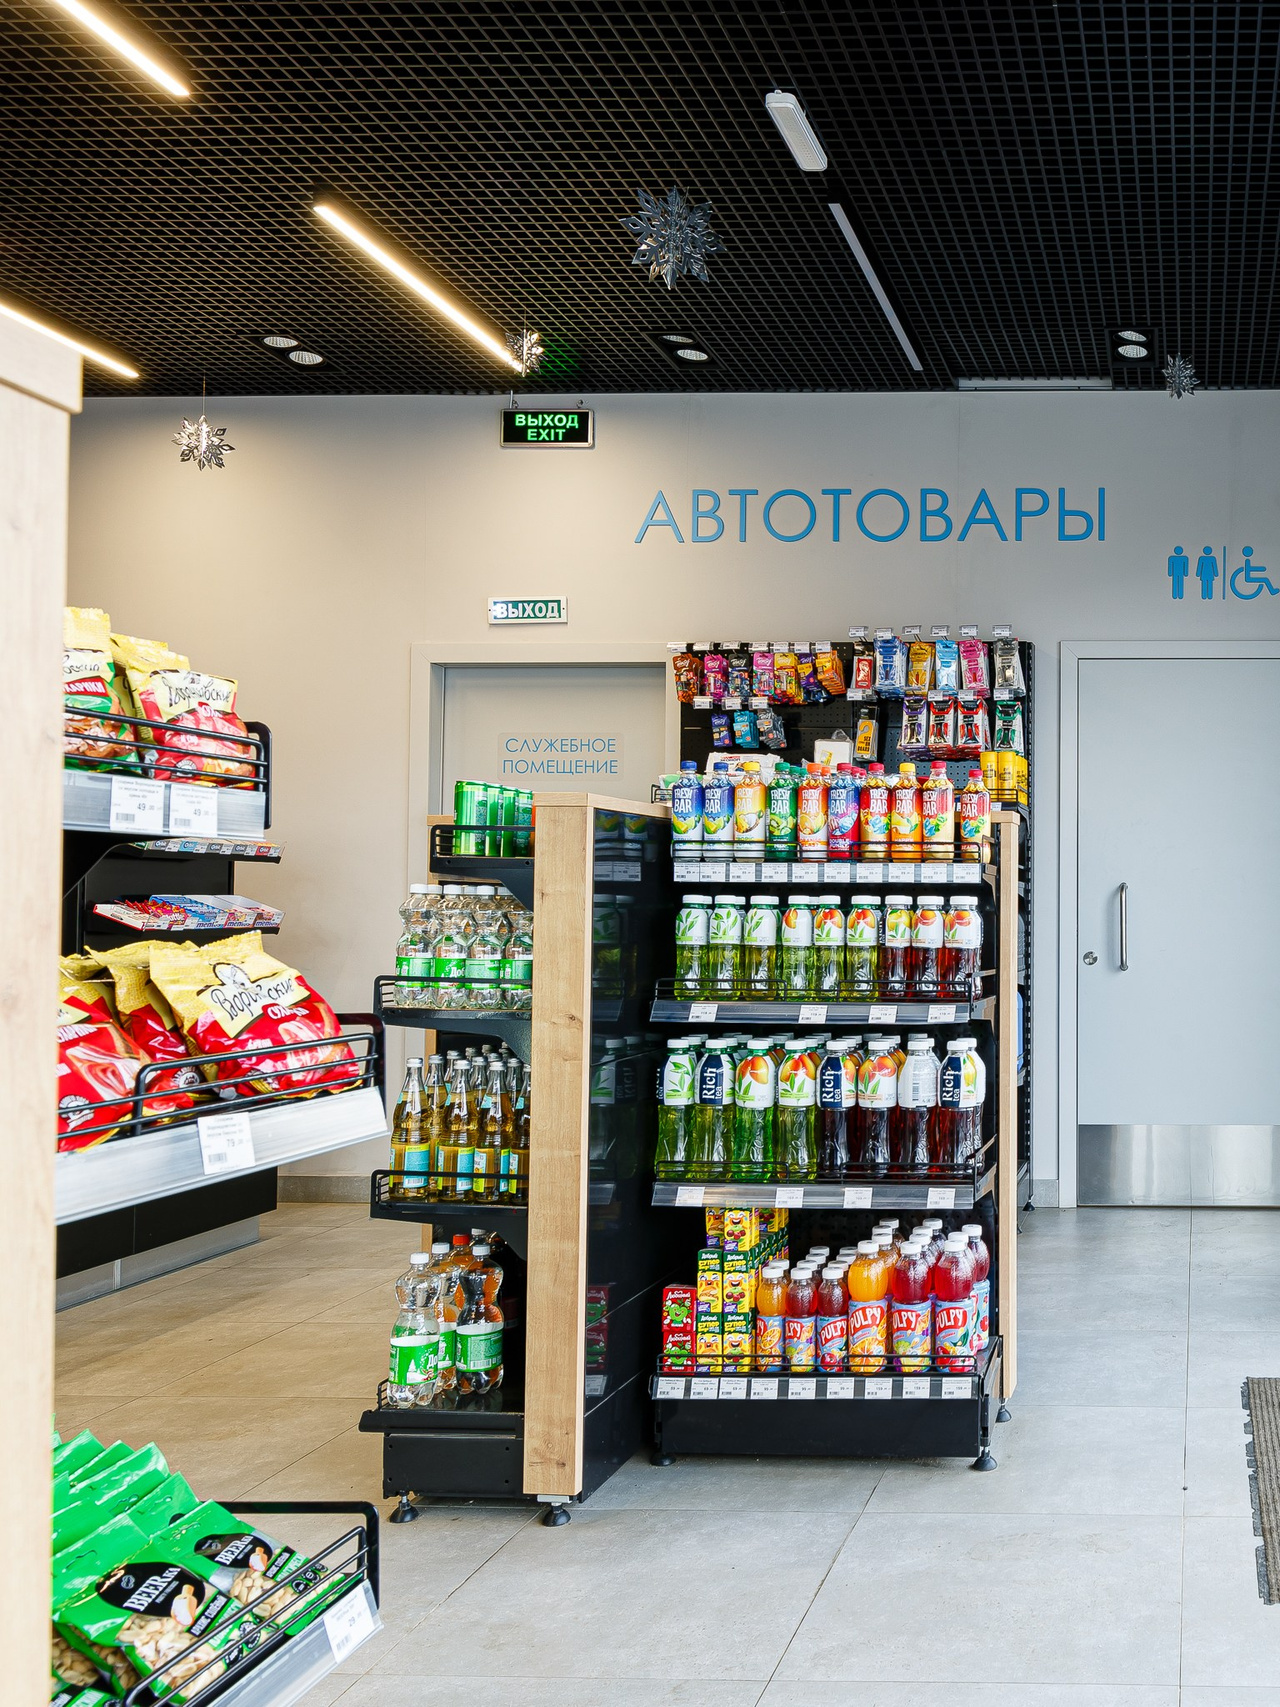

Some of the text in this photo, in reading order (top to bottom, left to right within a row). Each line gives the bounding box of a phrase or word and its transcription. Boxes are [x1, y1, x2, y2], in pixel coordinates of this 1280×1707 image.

[515, 414, 579, 428] ВЫХОД
[527, 429, 566, 441] EXIT
[634, 487, 1106, 543] АВТОТОВАРЫ
[497, 602, 560, 619] ВЫХОД
[505, 738, 616, 753] СЛУЖЕБНОЕ
[503, 759, 618, 775] ПОМЕЩЕНИЕ
[675, 788, 692, 799] FRESH
[705, 788, 722, 799] FRESH
[736, 788, 753, 799] FRESH
[771, 788, 790, 799] FRESH
[802, 788, 820, 799] FRESH
[831, 789, 847, 800] FRESH
[870, 788, 888, 799] FRESH
[895, 788, 914, 799] FRESH
[674, 799, 692, 813] BAR
[705, 799, 721, 813] BAR
[736, 799, 752, 813] BAR
[771, 799, 790, 814] BAR
[802, 799, 820, 813] BAR
[830, 800, 846, 814] BAR
[870, 799, 888, 813] BAR
[895, 799, 913, 813] BAR
[923, 802, 937, 816] BAR
[961, 803, 978, 817] BAR
[451, 966, 465, 978] Доб
[702, 1067, 717, 1099] Rich
[822, 1067, 835, 1102] Rich
[942, 1067, 954, 1102] Rich
[715, 1086, 723, 1100] tea
[834, 1088, 842, 1102] tea
[953, 1088, 961, 1102] tea
[851, 1306, 881, 1333] PULPY
[892, 1311, 917, 1328] ULPY
[936, 1309, 963, 1332] PULPY
[785, 1320, 800, 1339] LPY
[821, 1319, 847, 1344] PULPY
